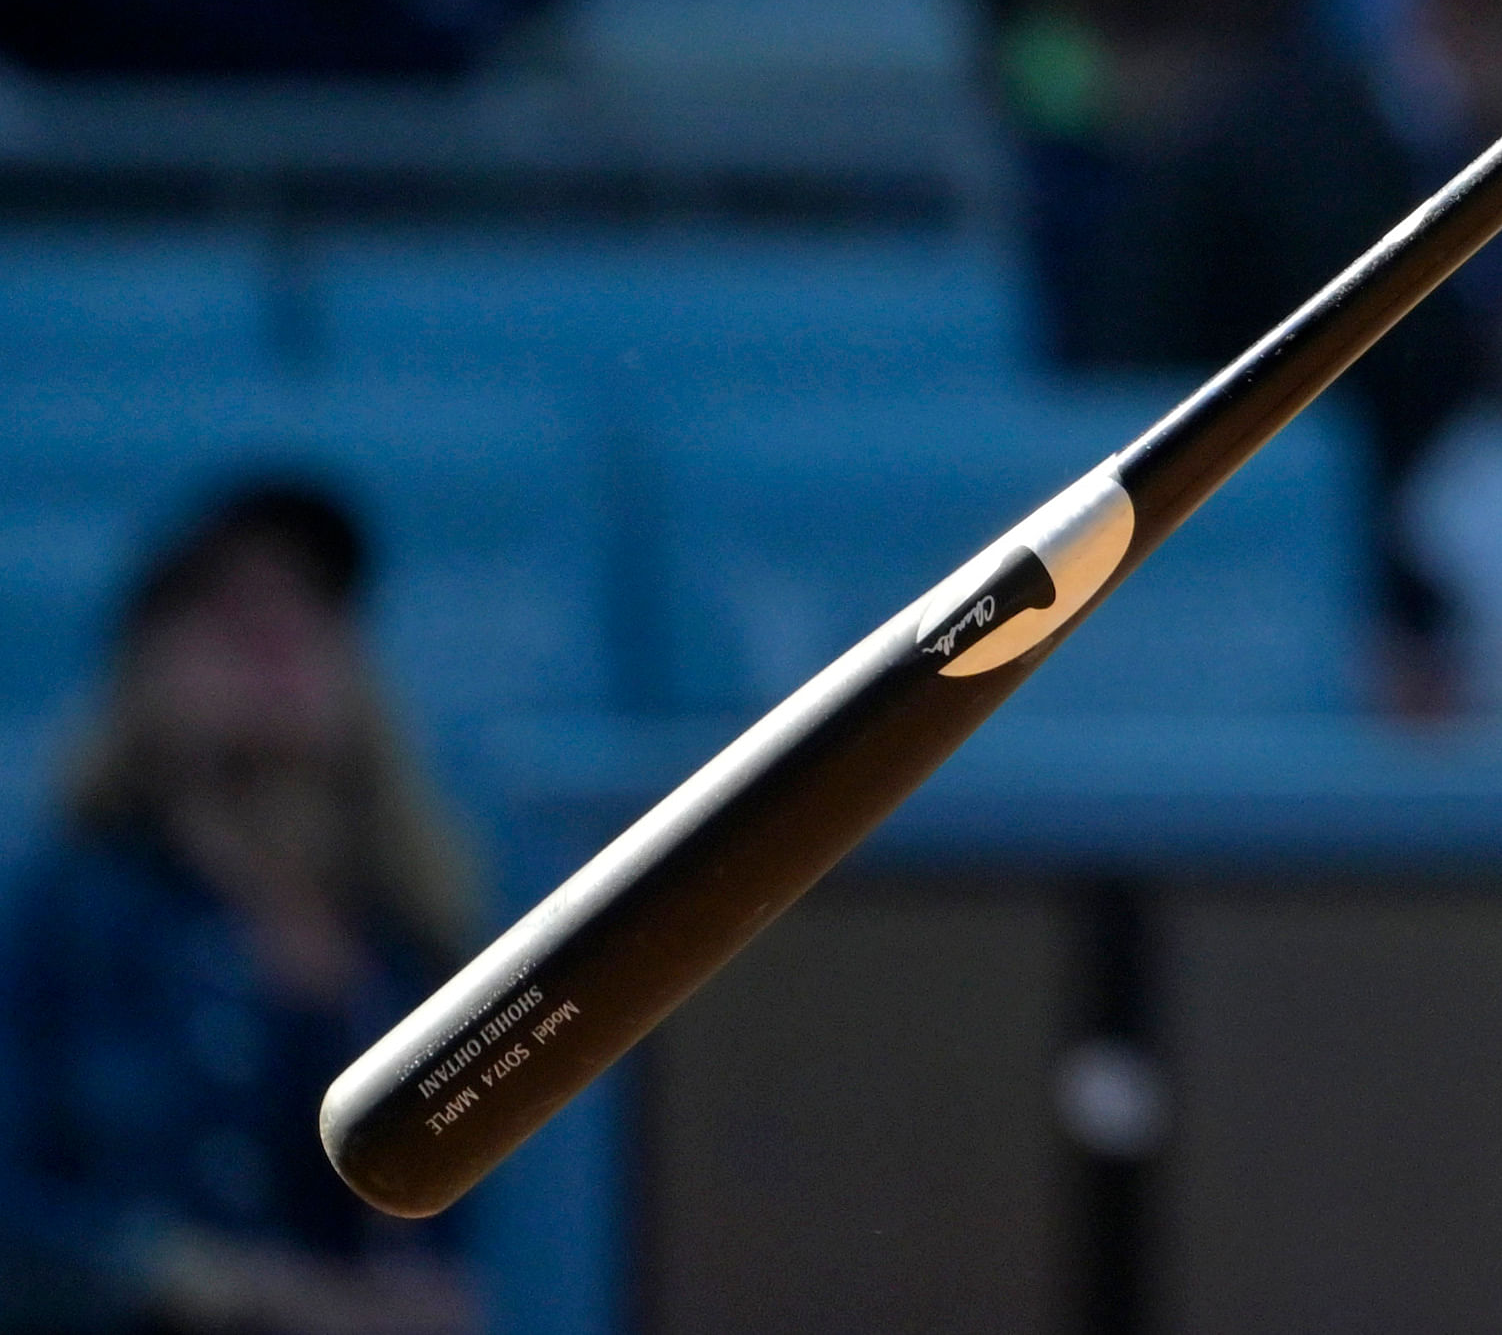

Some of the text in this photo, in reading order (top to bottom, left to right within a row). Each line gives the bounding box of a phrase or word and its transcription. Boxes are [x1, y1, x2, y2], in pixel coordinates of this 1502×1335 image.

[417, 984, 544, 1100] SHOHEI OHTANI
[531, 999, 581, 1045] Model
[425, 1085, 480, 1136] MAPLE
